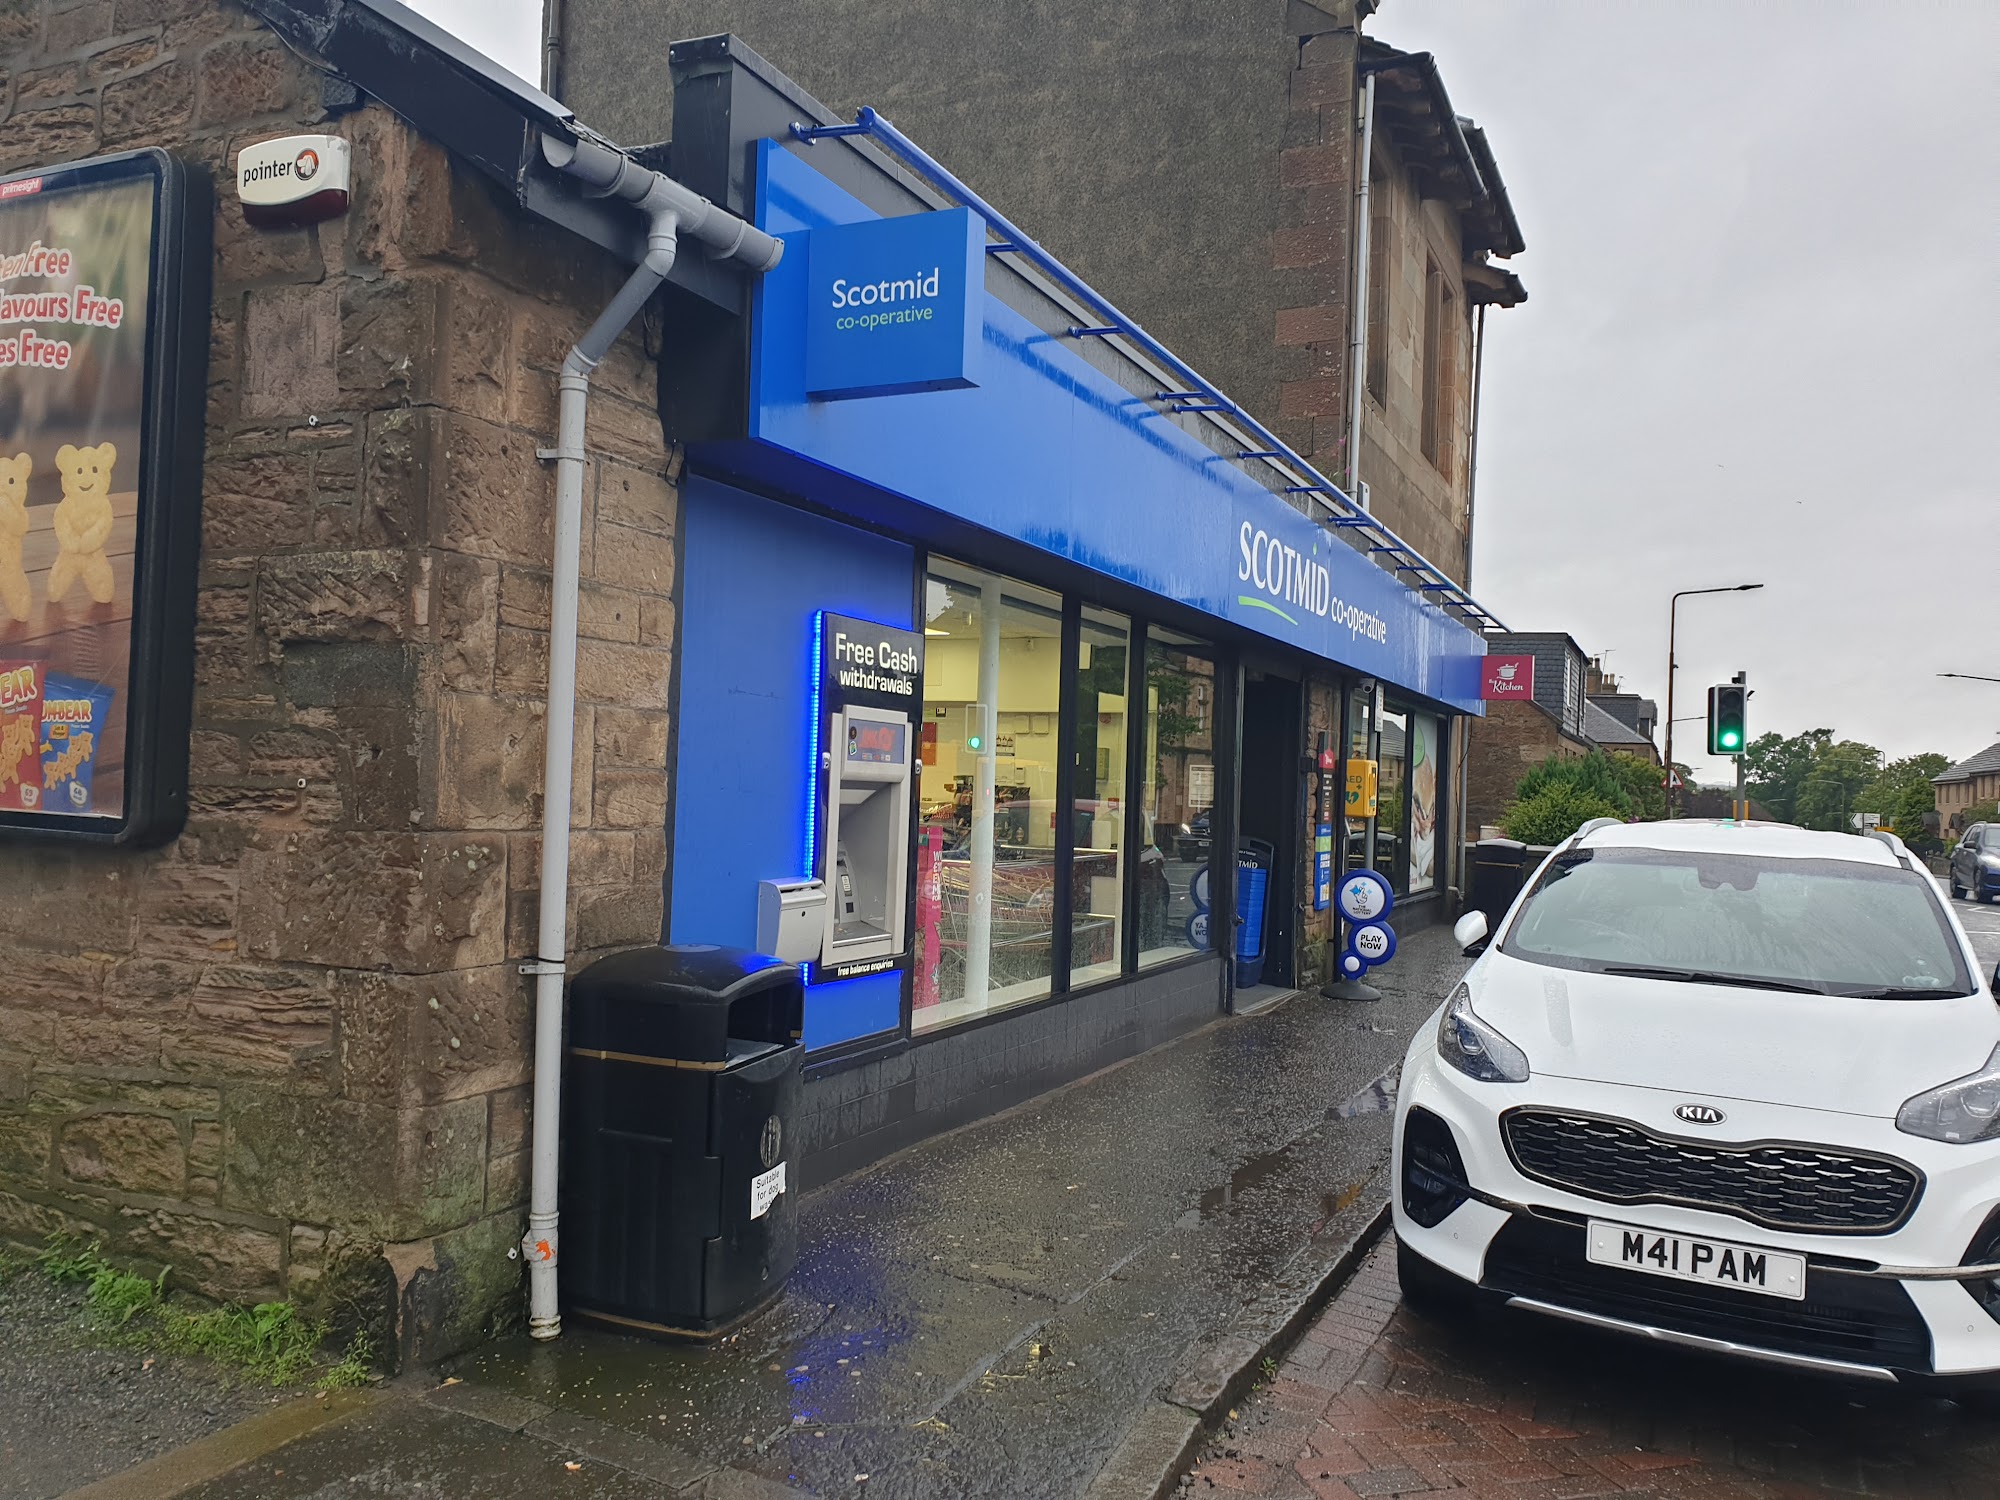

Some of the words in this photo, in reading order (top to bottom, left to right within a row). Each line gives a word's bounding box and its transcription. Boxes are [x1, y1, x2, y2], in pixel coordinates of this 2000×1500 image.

[243, 161, 293, 187] pointer
[2, 178, 39, 197] primesight
[22, 243, 71, 276] Free
[832, 267, 939, 308] Scotmid
[75, 288, 122, 325] Free
[836, 305, 933, 331] co-operative
[20, 331, 70, 367] Free
[1331, 597, 1387, 644] co-operative
[836, 632, 875, 666] Free
[879, 641, 918, 674] Cash
[840, 667, 913, 696] withdrawals
[1492, 680, 1523, 694] Kitchen
[1360, 934, 1382, 943] PLAY
[1360, 942, 1382, 950] NOW
[837, 966, 849, 977] free
[850, 964, 870, 975] balance
[871, 959, 894, 972] enquiries
[1682, 1106, 1718, 1122] KIA
[756, 1170, 780, 1189] Suitable
[757, 1190, 767, 1201] for
[768, 1183, 779, 1195] dog
[1622, 1231, 1679, 1271] M41
[1691, 1242, 1767, 1287] PAM
